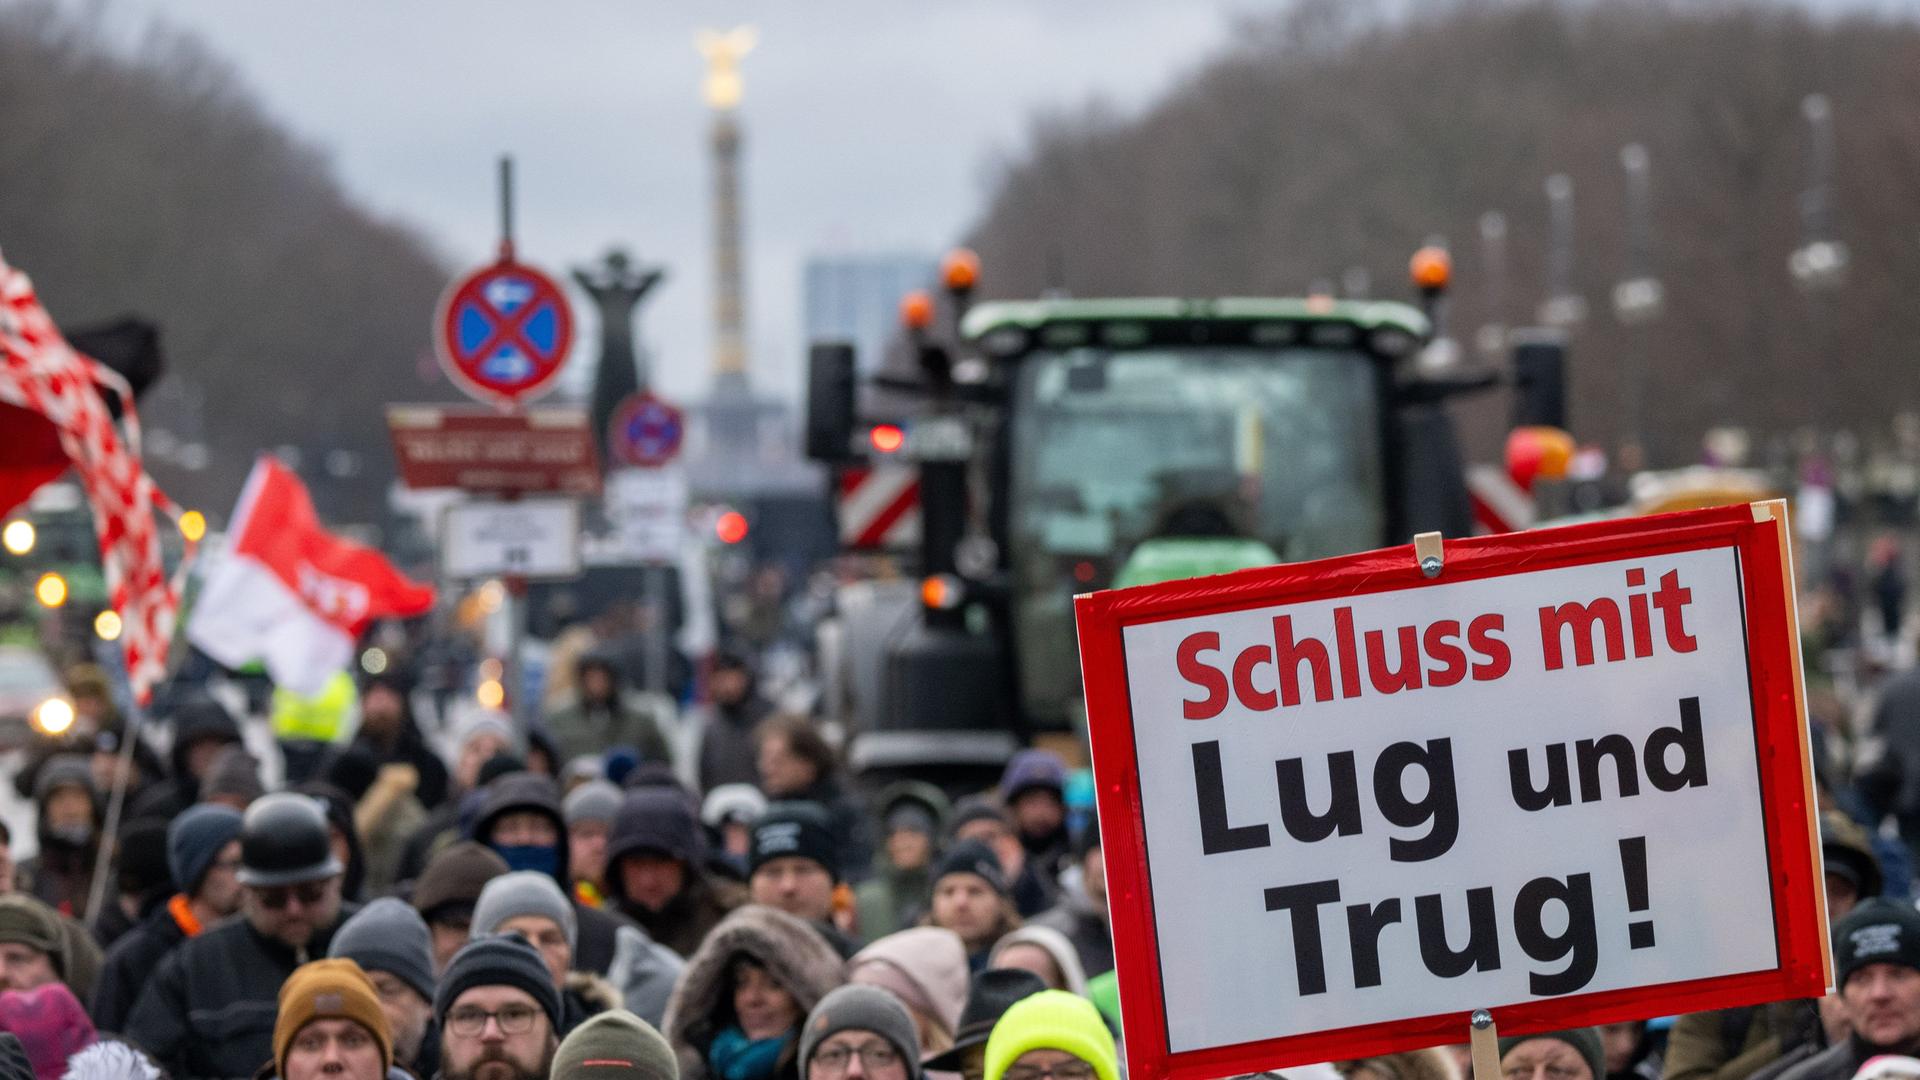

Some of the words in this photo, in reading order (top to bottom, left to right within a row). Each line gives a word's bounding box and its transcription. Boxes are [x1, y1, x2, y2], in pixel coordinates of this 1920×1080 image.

[1176, 605, 1512, 721] Schluss
[1539, 568, 1698, 672] mit
[1192, 737, 1460, 863] Lug
[1507, 696, 1709, 812] und
